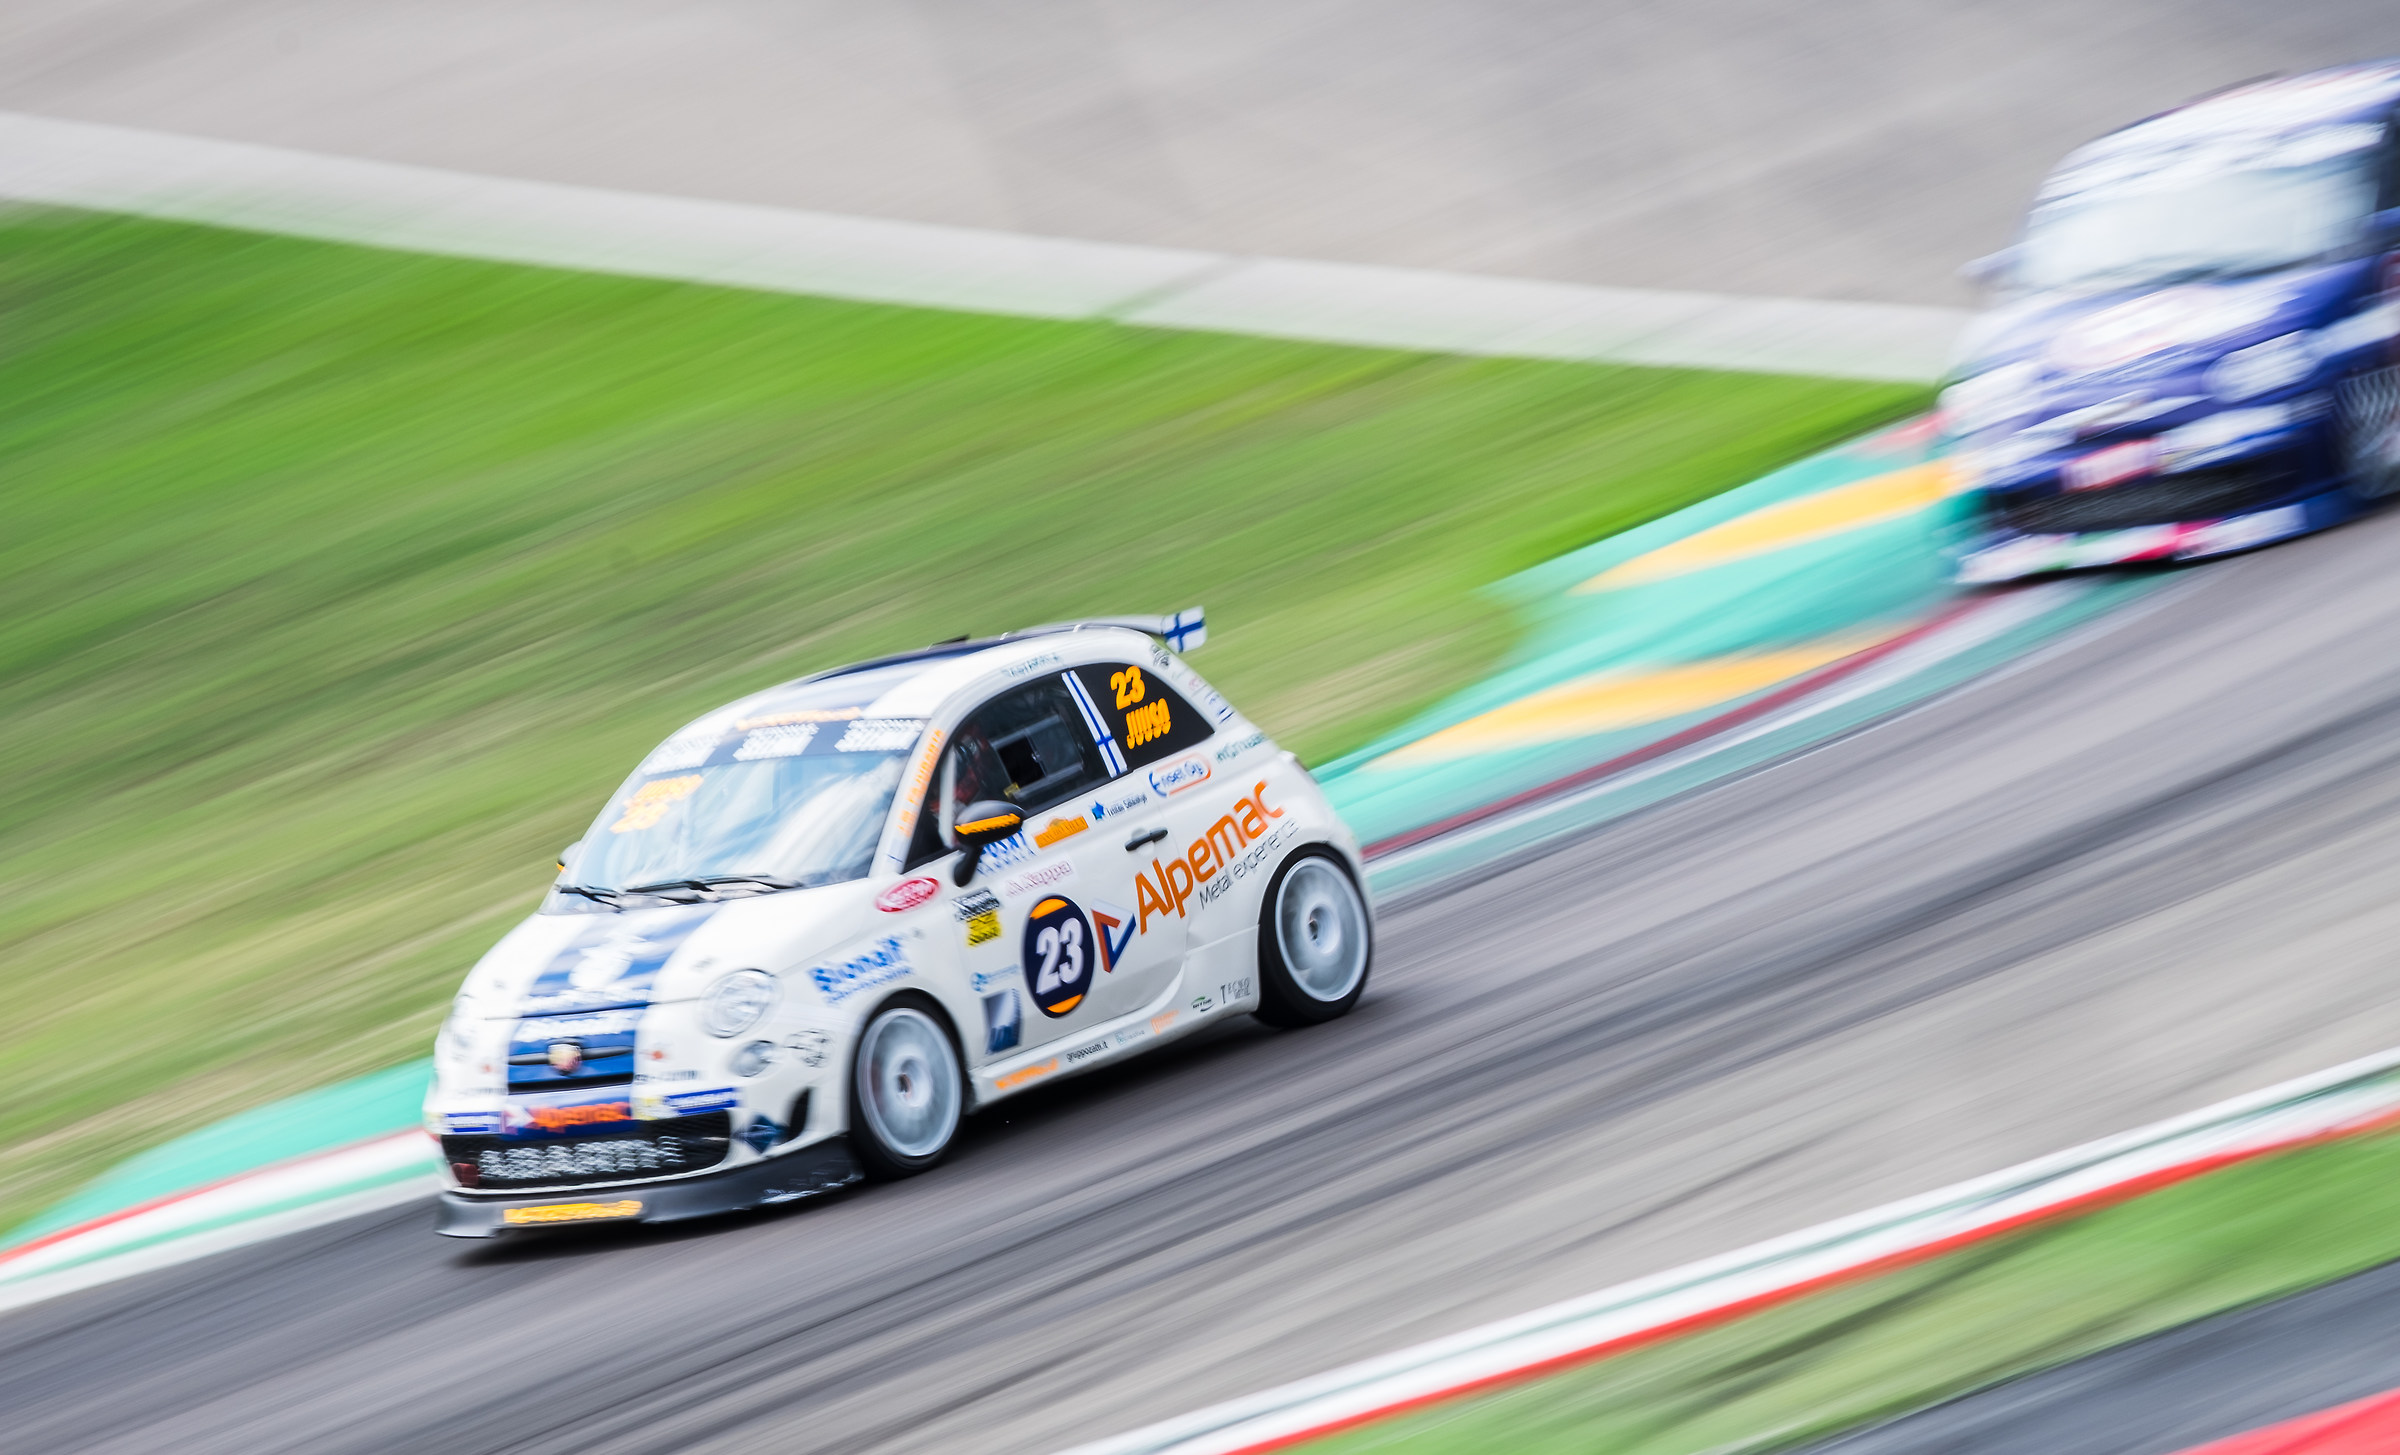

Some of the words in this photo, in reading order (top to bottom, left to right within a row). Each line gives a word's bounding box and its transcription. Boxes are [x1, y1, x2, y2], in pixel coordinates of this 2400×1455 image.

[1110, 666, 1146, 710] 23
[1135, 779, 1286, 936] Alpemac
[1199, 866, 1235, 910] Metal
[1232, 818, 1300, 880] experience
[1035, 917, 1084, 995] 23
